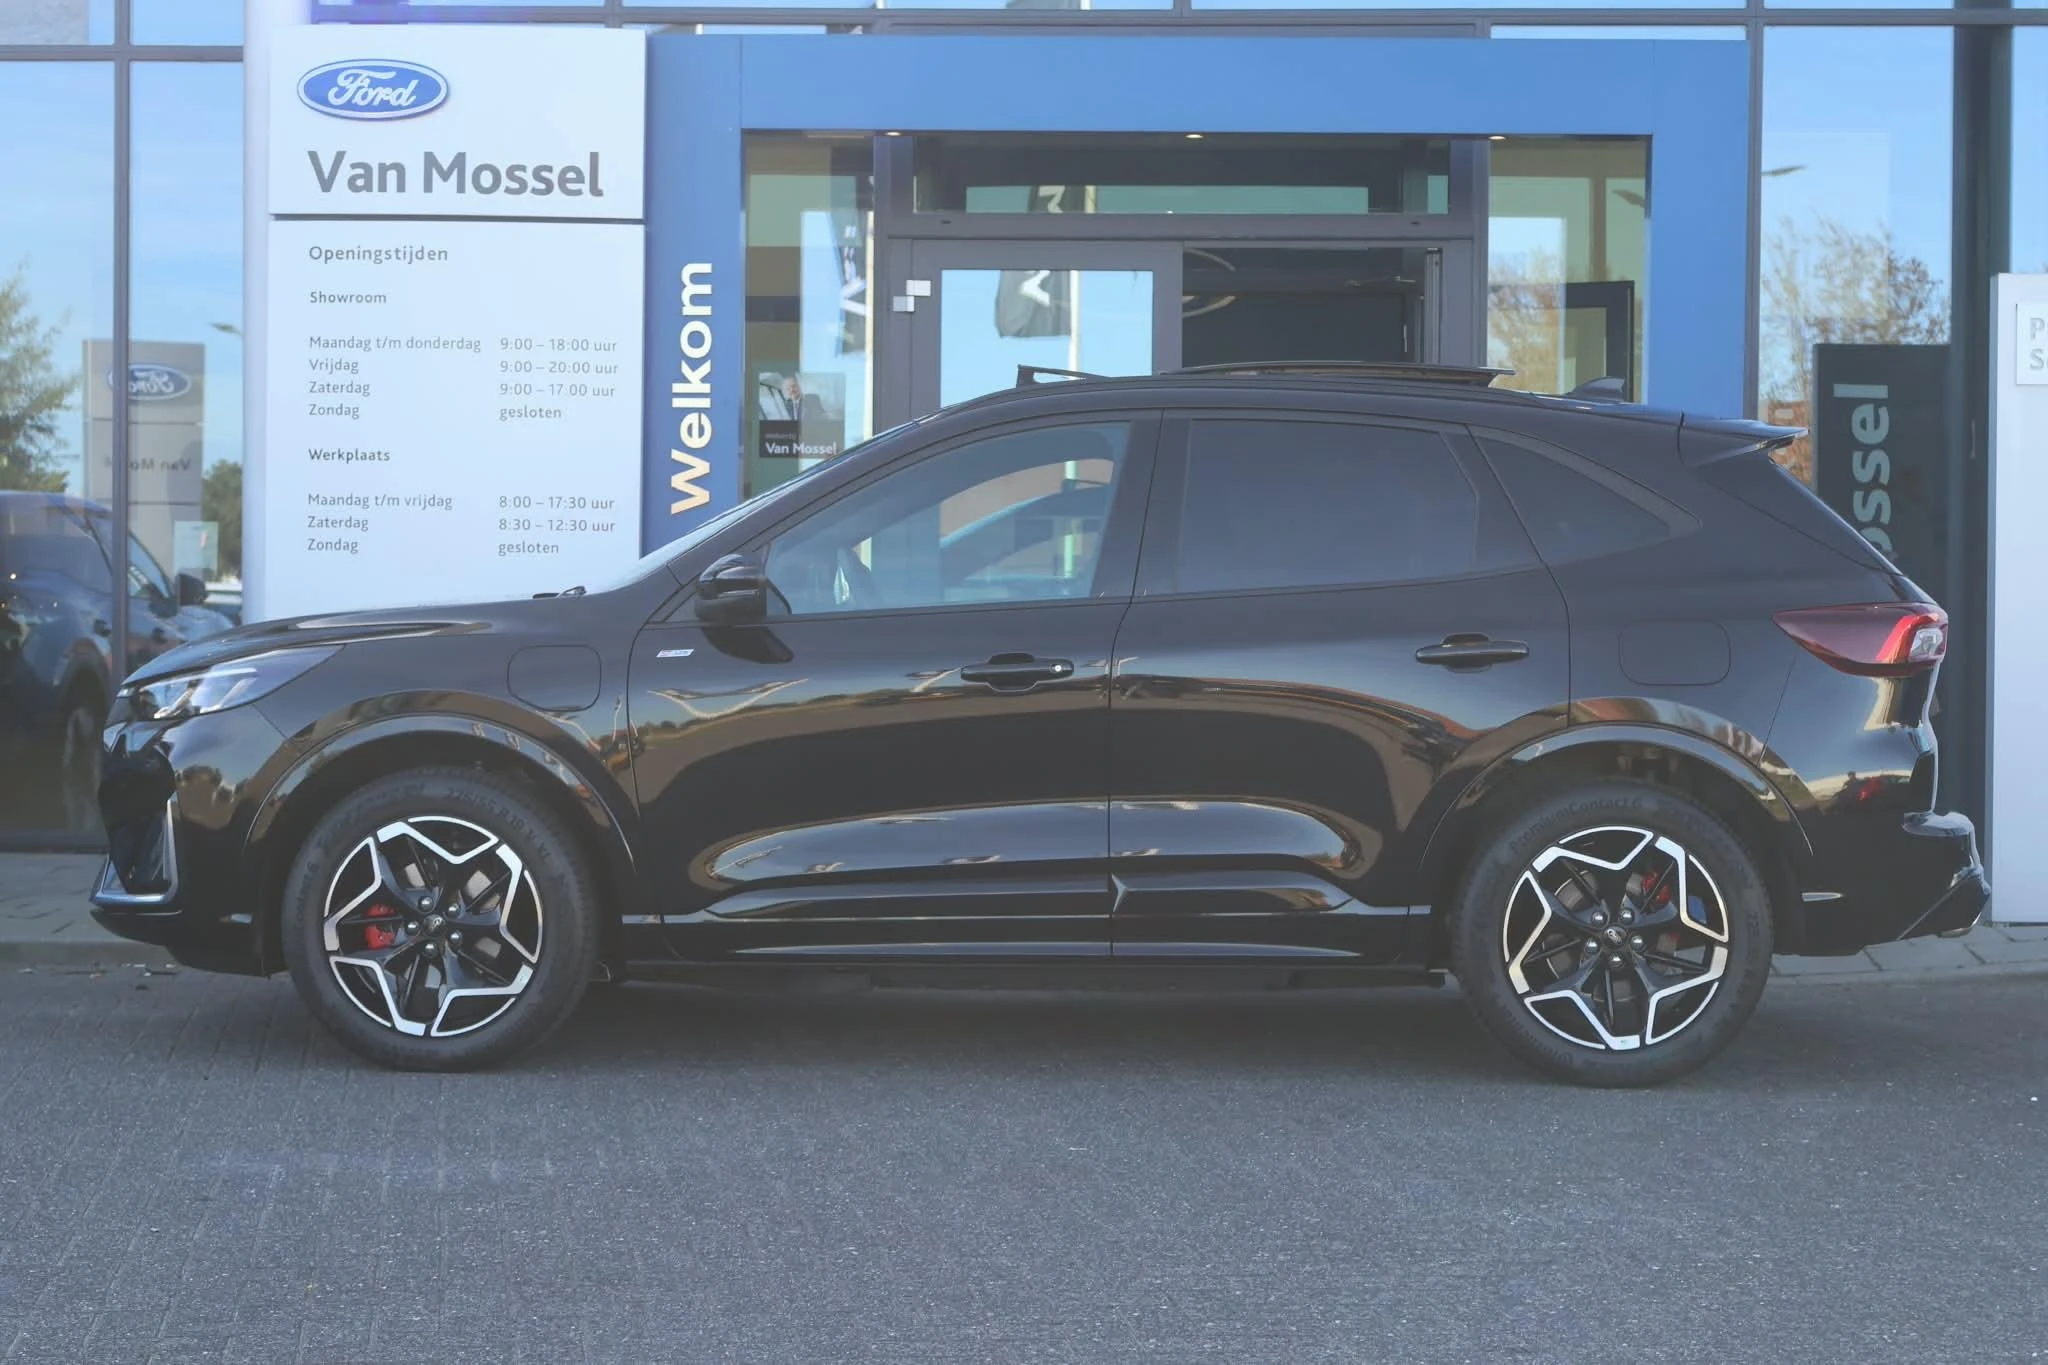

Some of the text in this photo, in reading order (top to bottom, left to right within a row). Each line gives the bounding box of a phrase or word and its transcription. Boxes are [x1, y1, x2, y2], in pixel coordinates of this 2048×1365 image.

[328, 68, 419, 106] Ford
[307, 150, 604, 198] Van Mossel
[308, 244, 449, 265] Openingstijden
[309, 290, 387, 305] Showroom
[2030, 317, 2048, 340] P
[309, 335, 481, 354] Maandag t/m donderdag
[500, 337, 533, 351] 9:00
[549, 337, 590, 352] 18:00
[594, 341, 618, 352] uur
[308, 357, 360, 376] Vrijdag
[499, 359, 533, 373] 9:00
[548, 360, 591, 374] 20:00
[595, 363, 619, 375] uur
[2030, 348, 2048, 370] S
[308, 379, 371, 398] Zaterdag
[499, 382, 533, 396] 9:00
[549, 383, 589, 397] 17:00
[592, 386, 616, 397] uur
[671, 262, 713, 515] Welkom
[308, 402, 360, 421] Zondag
[499, 404, 563, 422] gesloten
[308, 447, 391, 466] Werkplaats
[764, 441, 838, 456] Van Mossel
[1833, 383, 1893, 554] ossel
[307, 492, 453, 511] Maandag t/m vrijdag
[499, 495, 532, 509] 8:00
[547, 495, 587, 510] 17:30
[591, 498, 615, 510] uur
[307, 515, 369, 533] Zaterdag
[499, 517, 531, 531] 8:30
[547, 518, 588, 532] 12:30
[591, 521, 616, 532] uur
[307, 537, 359, 556] Zondag
[498, 539, 559, 558] gesloten
